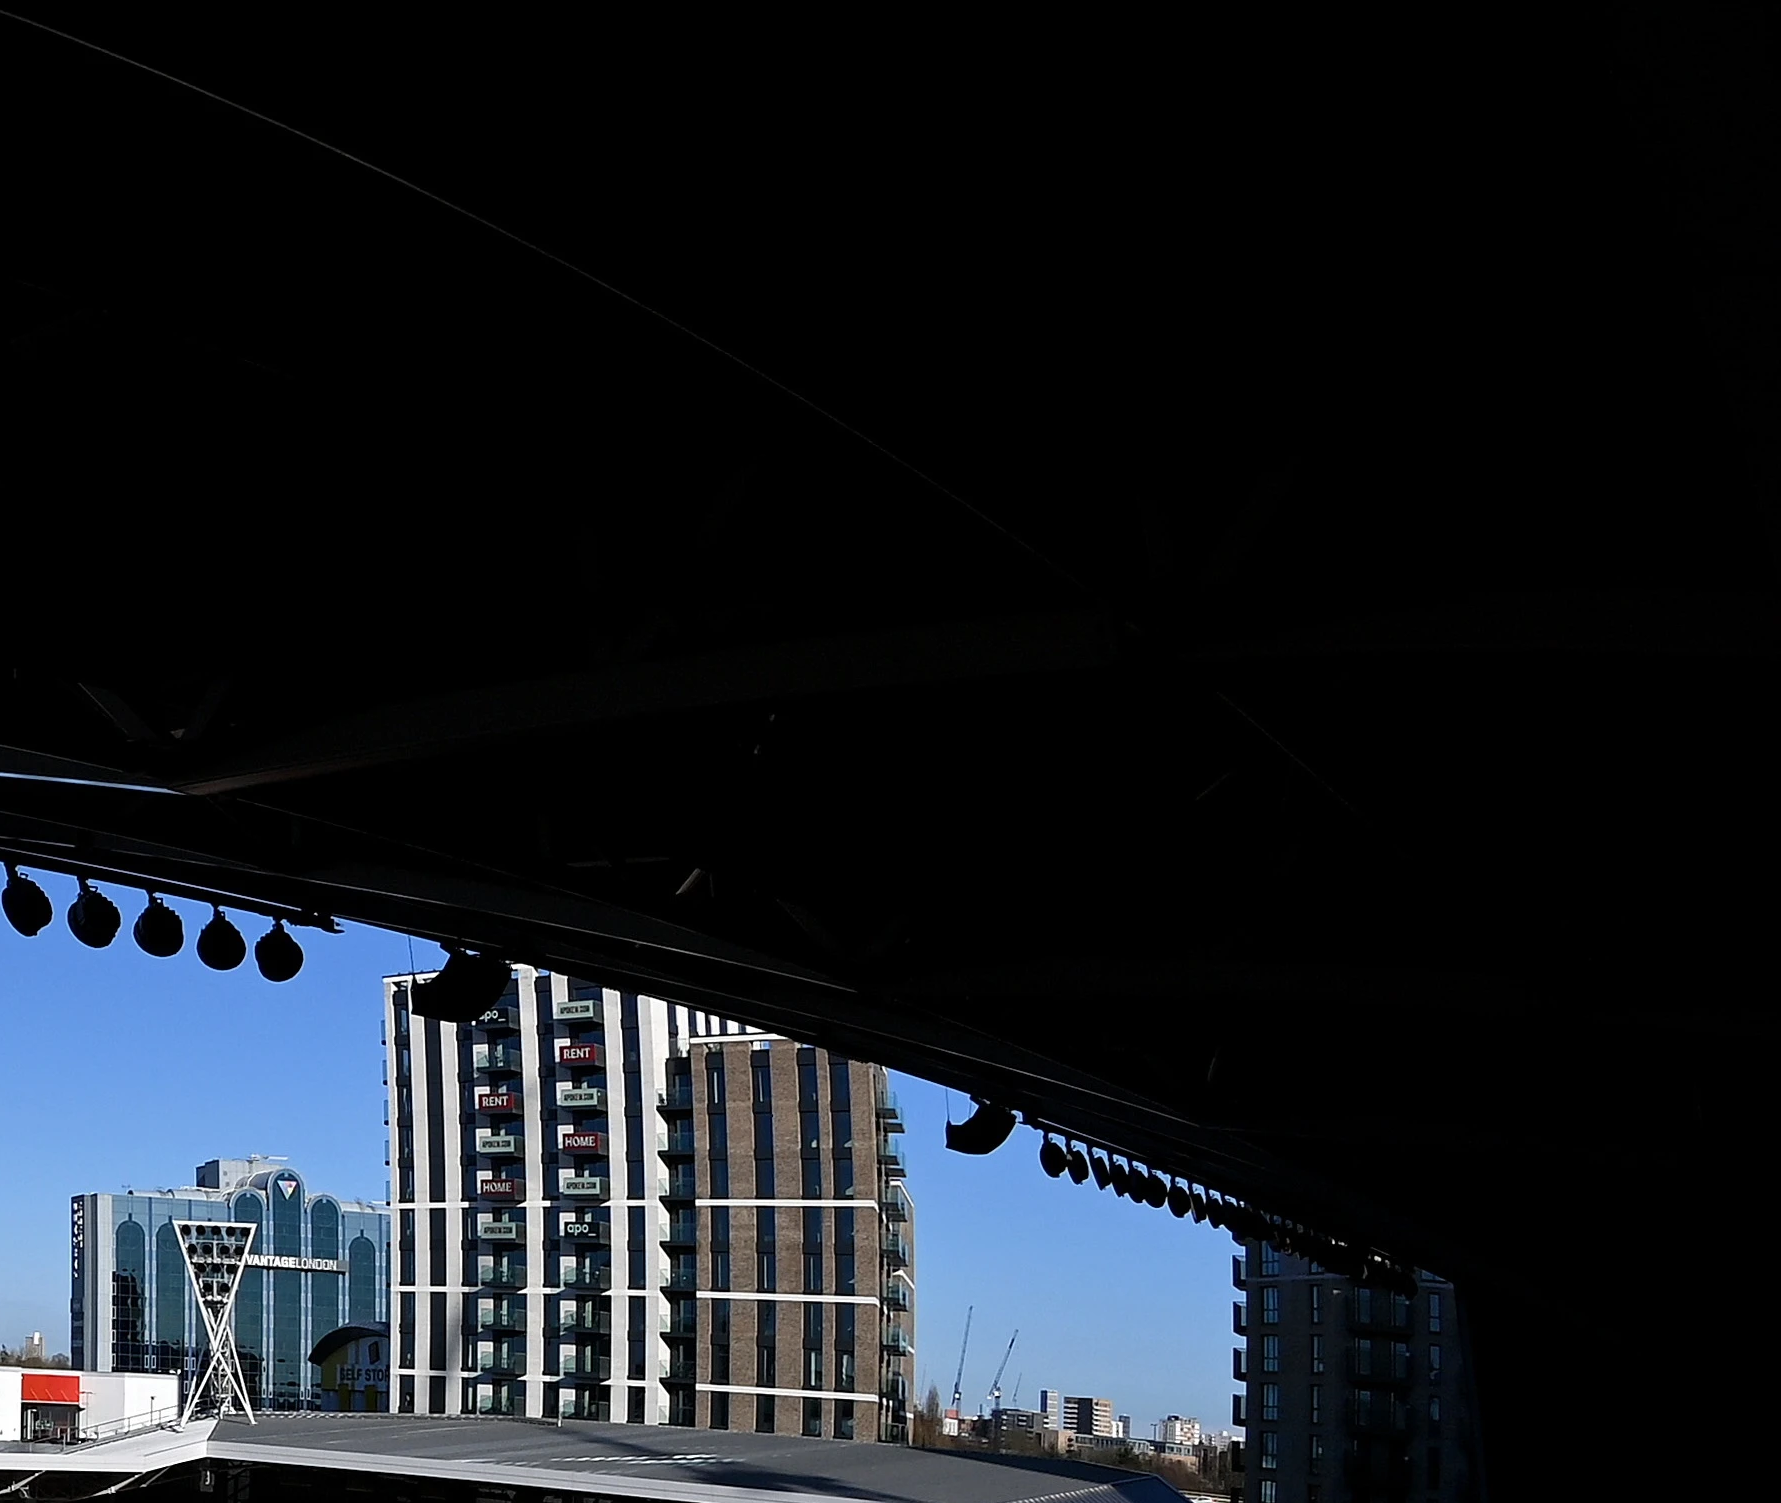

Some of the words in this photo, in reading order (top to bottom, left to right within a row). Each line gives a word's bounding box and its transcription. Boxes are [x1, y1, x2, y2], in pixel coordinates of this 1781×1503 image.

[563, 1047, 591, 1060] RENT
[481, 1095, 509, 1107] RENT
[565, 1135, 596, 1147] HOME
[482, 1181, 512, 1193] HOME
[339, 1367, 363, 1381] SELF
